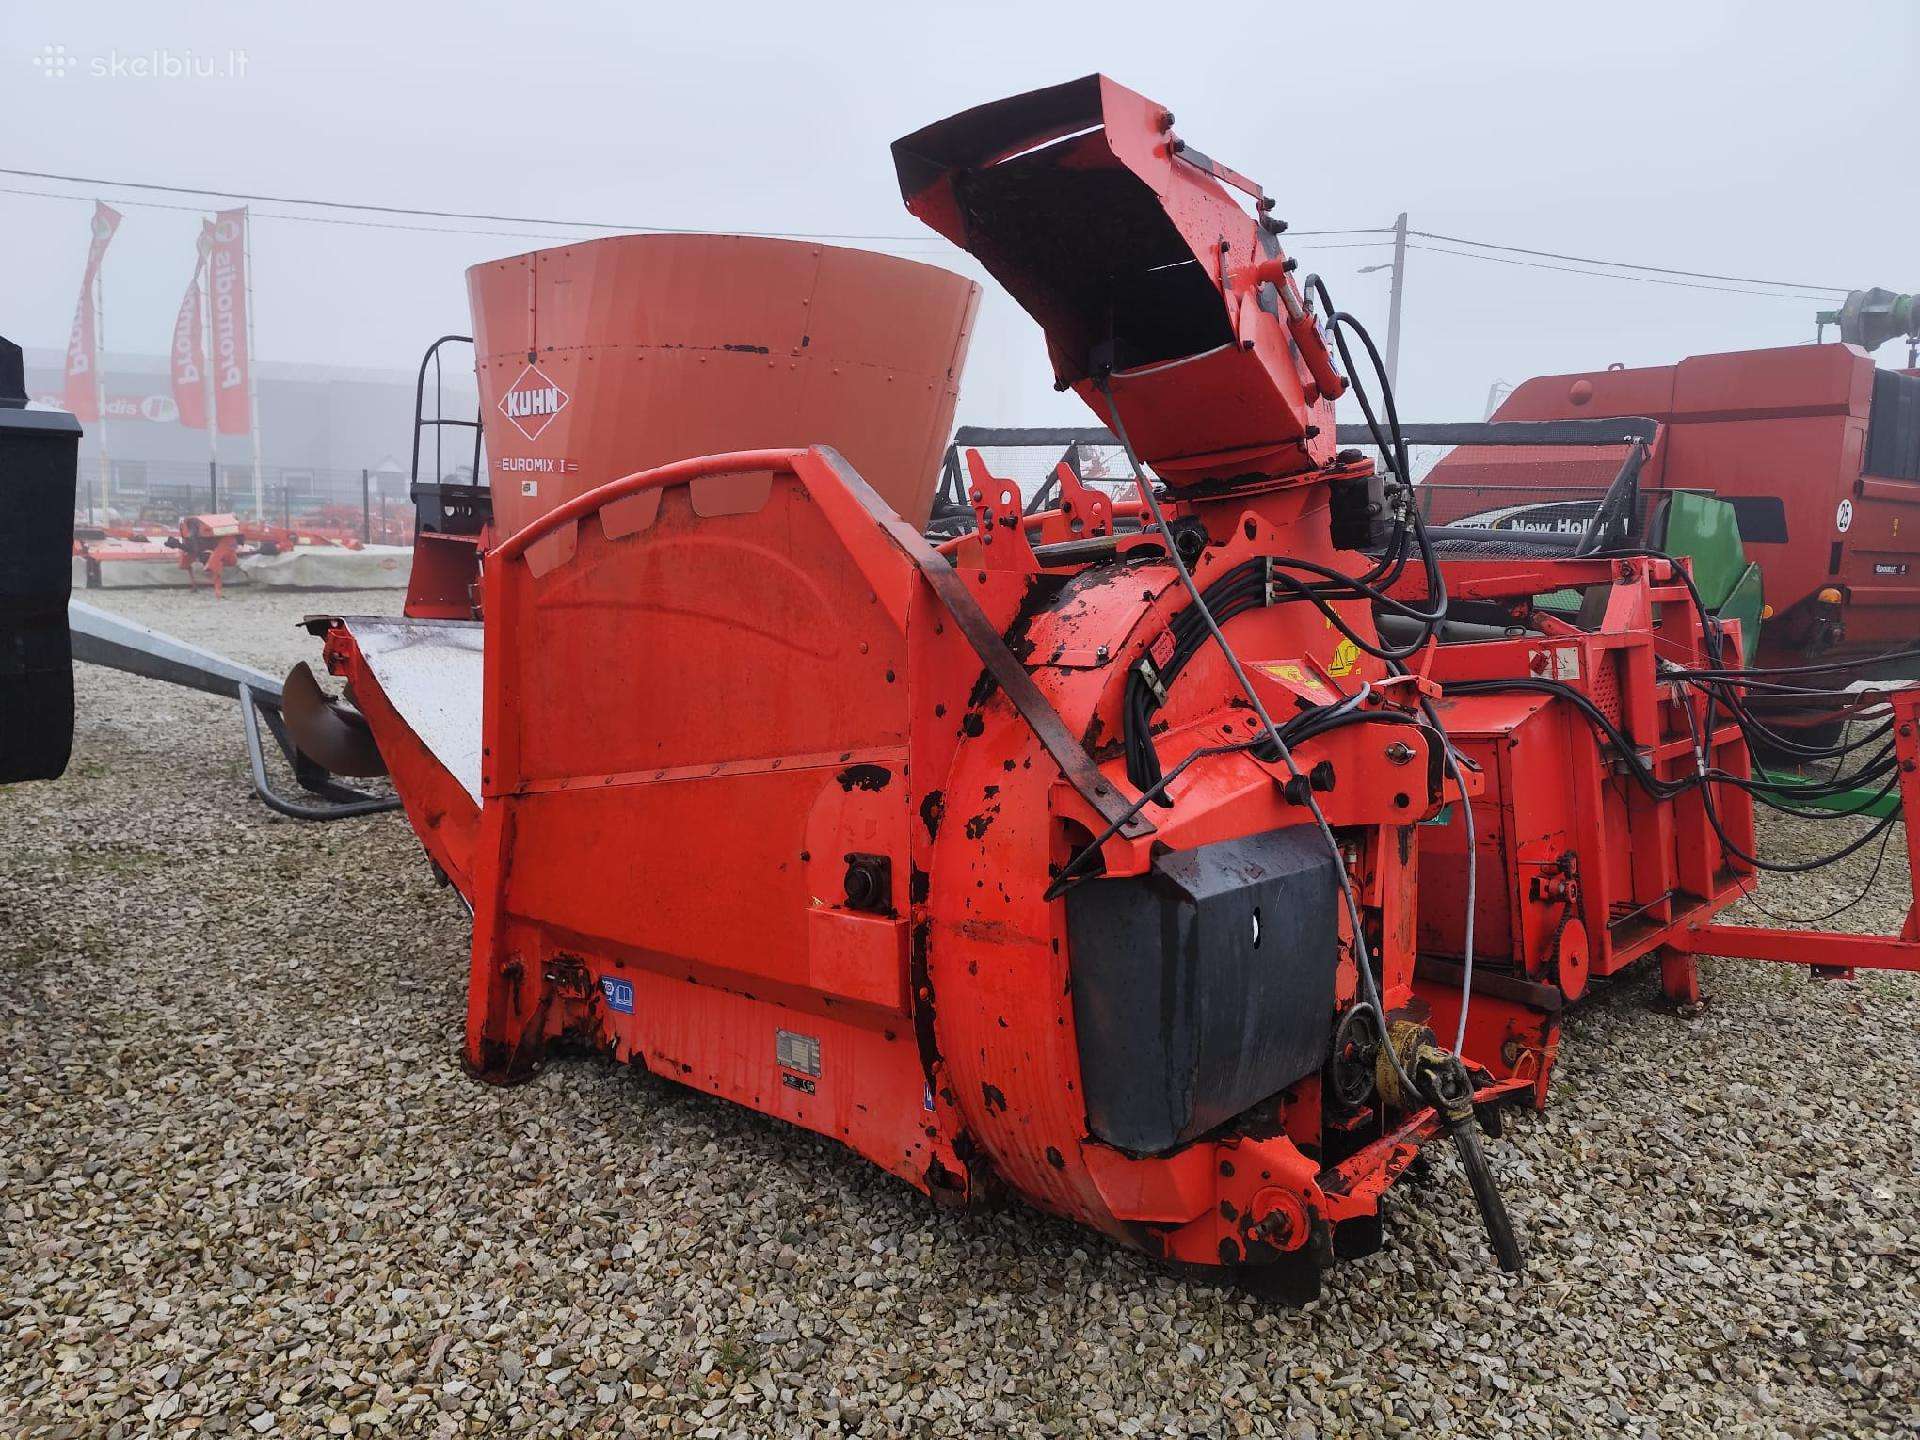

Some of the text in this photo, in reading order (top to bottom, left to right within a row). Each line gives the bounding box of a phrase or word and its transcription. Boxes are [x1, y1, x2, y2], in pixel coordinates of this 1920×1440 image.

[507, 388, 558, 417] KUHN
[502, 458, 554, 472] EUROMIX
[1839, 503, 1850, 528] 25
[1511, 519, 1553, 533] New
